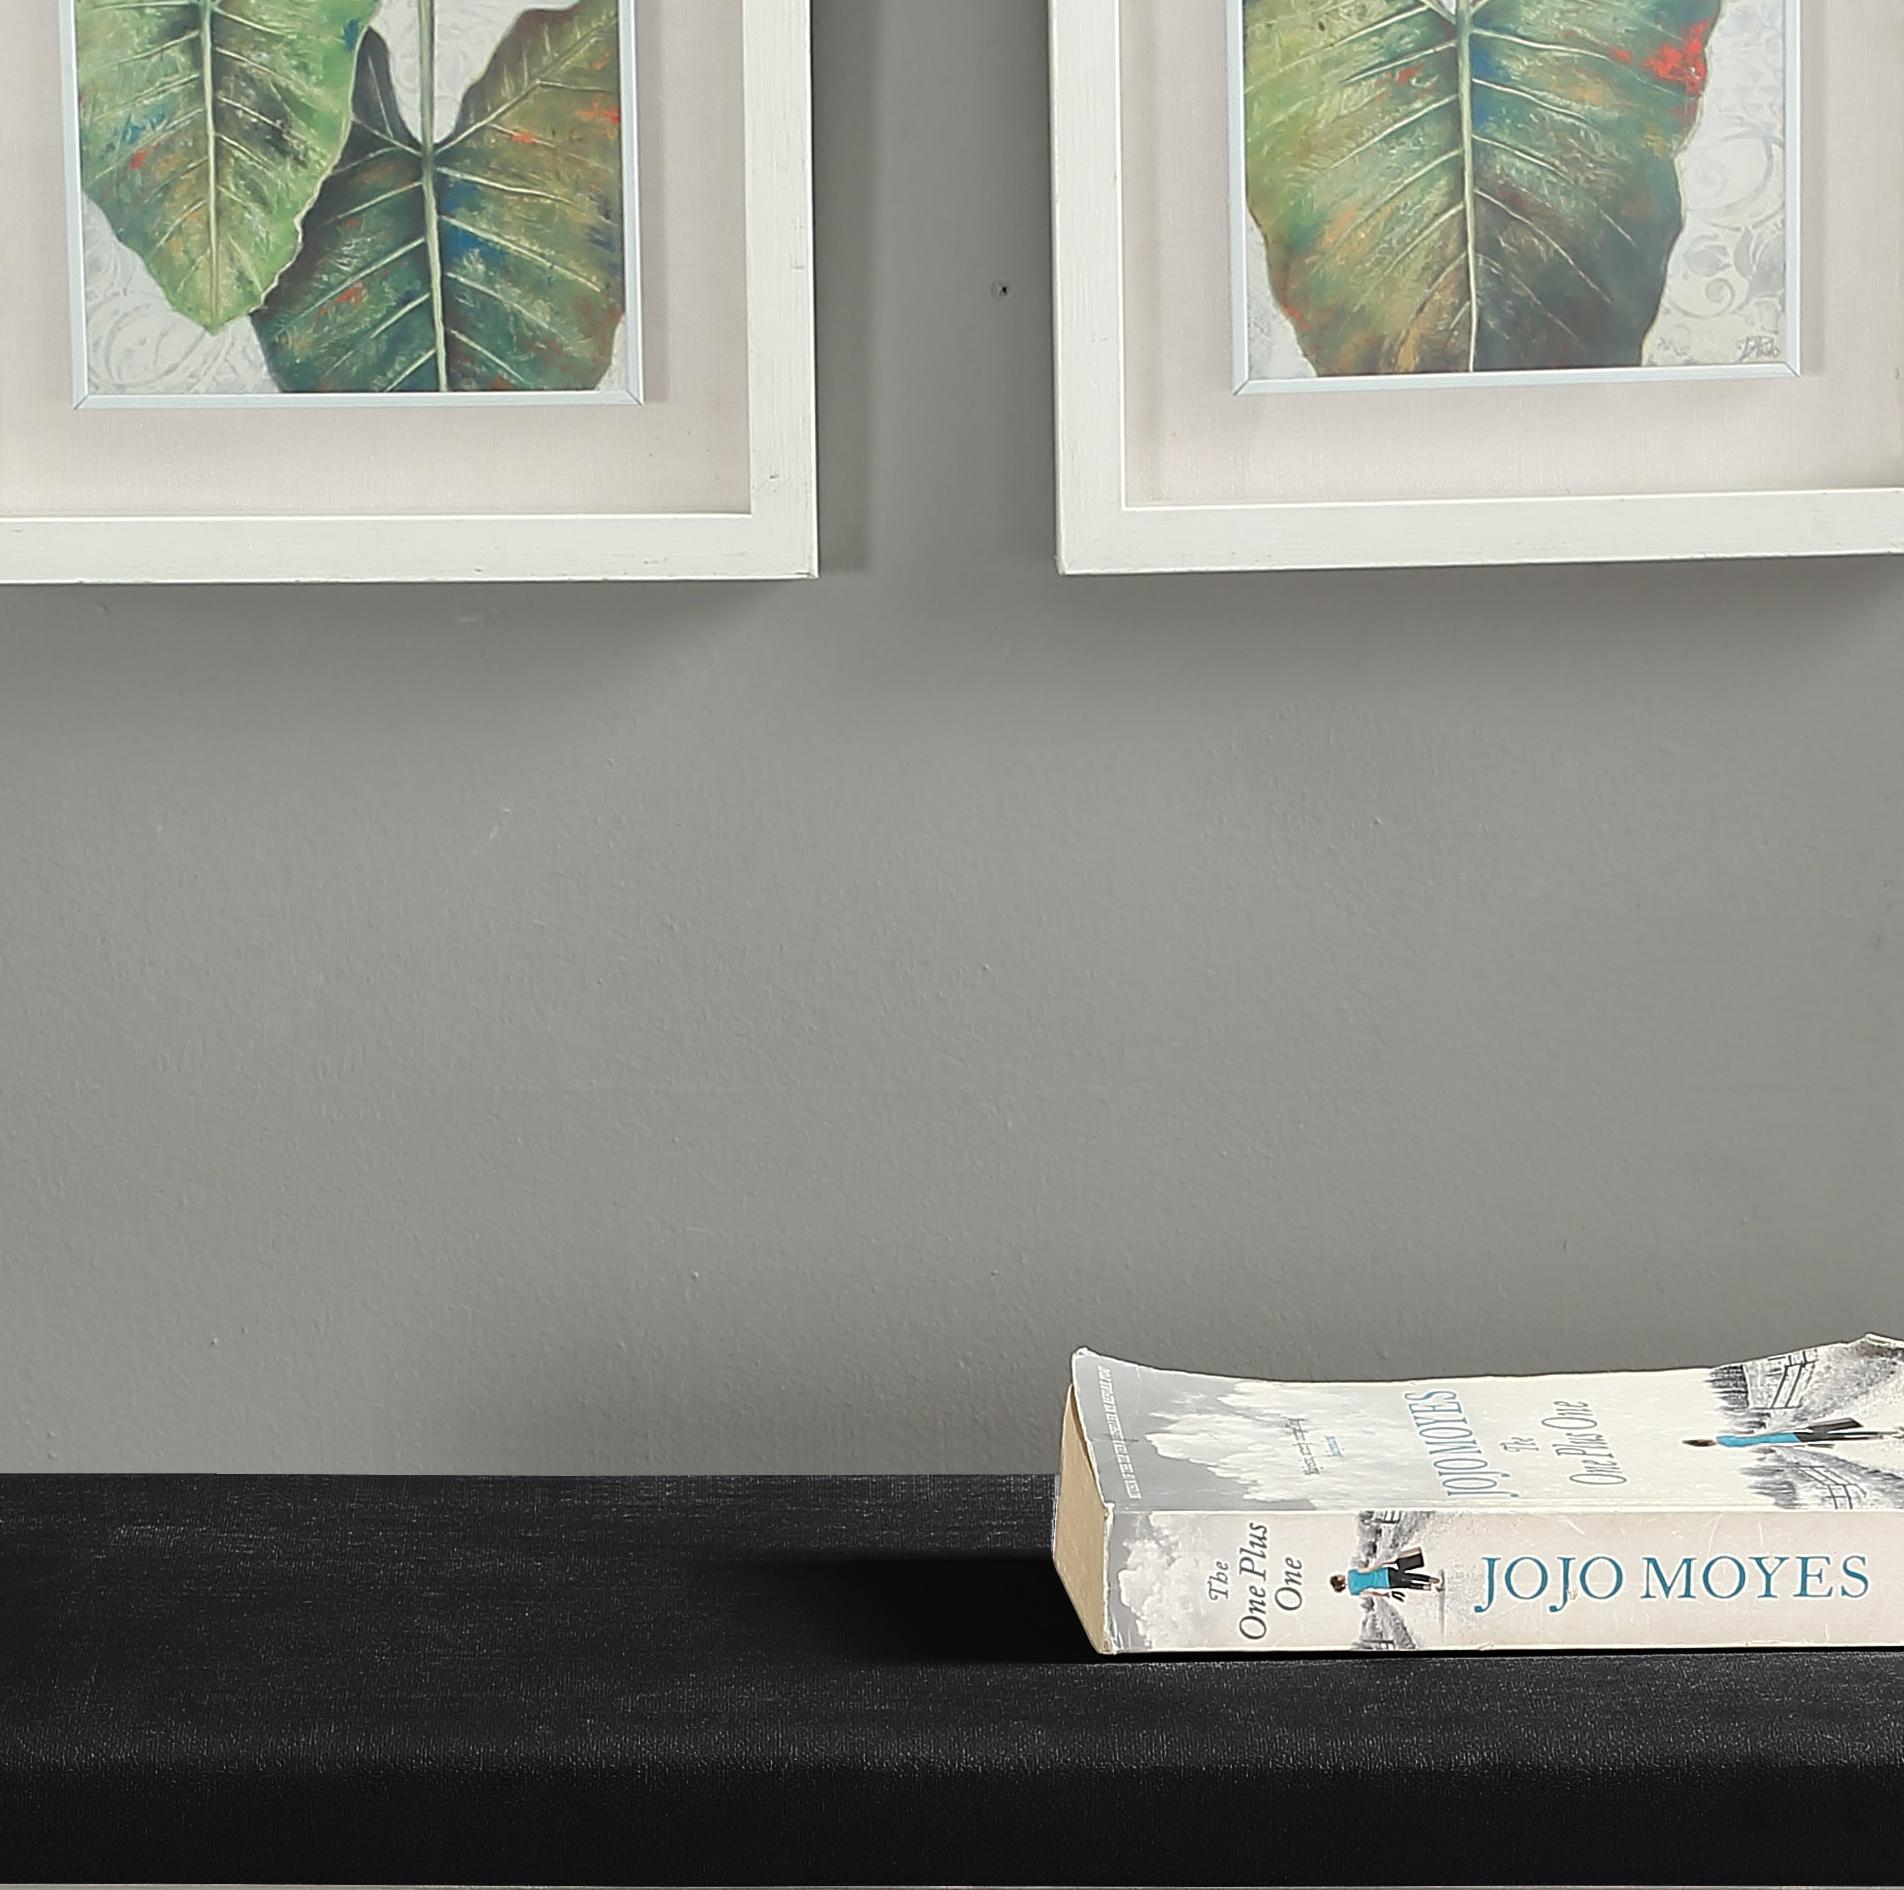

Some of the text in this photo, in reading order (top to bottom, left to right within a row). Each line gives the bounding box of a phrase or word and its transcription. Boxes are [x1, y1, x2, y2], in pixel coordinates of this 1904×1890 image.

[1404, 1390, 1520, 1498] JOJO MOYES
[1500, 1436, 1540, 1452] The
[1541, 1400, 1627, 1485] One Plus One
[1207, 1561, 1228, 1600] The
[1239, 1522, 1267, 1640] One Plus
[1274, 1557, 1302, 1611] One
[1474, 1555, 1869, 1613] JOJO MOYES
